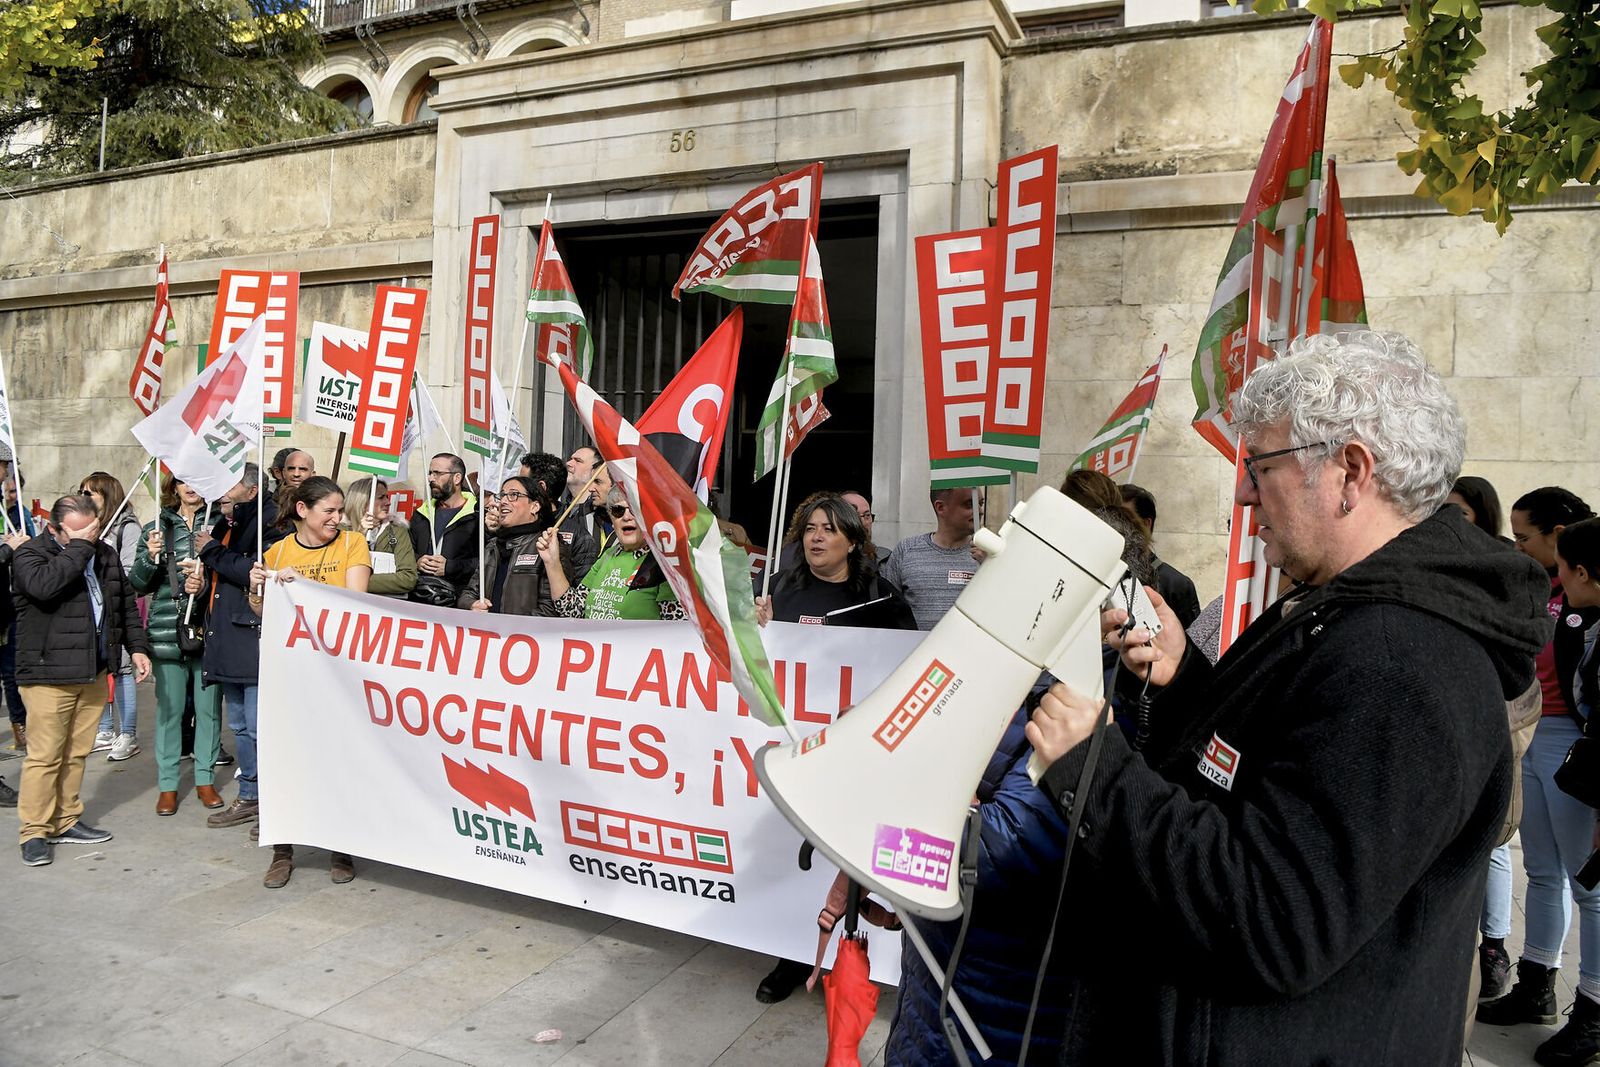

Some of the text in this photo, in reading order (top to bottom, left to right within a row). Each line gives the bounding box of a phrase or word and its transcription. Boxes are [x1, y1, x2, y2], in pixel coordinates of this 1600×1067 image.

[670, 130, 697, 152] 56
[994, 158, 1044, 426] CCOO
[470, 222, 494, 423] CCOO
[934, 236, 990, 452] CCOO
[319, 376, 360, 400] UST
[361, 291, 416, 450] CCOO
[317, 396, 358, 412] INTERSIN
[334, 411, 356, 422] AND
[286, 604, 540, 685] AUMENTO
[879, 679, 937, 746] CCOO
[932, 677, 963, 716] granada
[363, 679, 686, 794] DOCENTES,
[1200, 761, 1229, 787] anza
[452, 806, 543, 856] USTEA
[475, 845, 526, 866] ENSEÑANZA
[567, 806, 695, 861] CCOO
[569, 853, 735, 903] enseñanza
